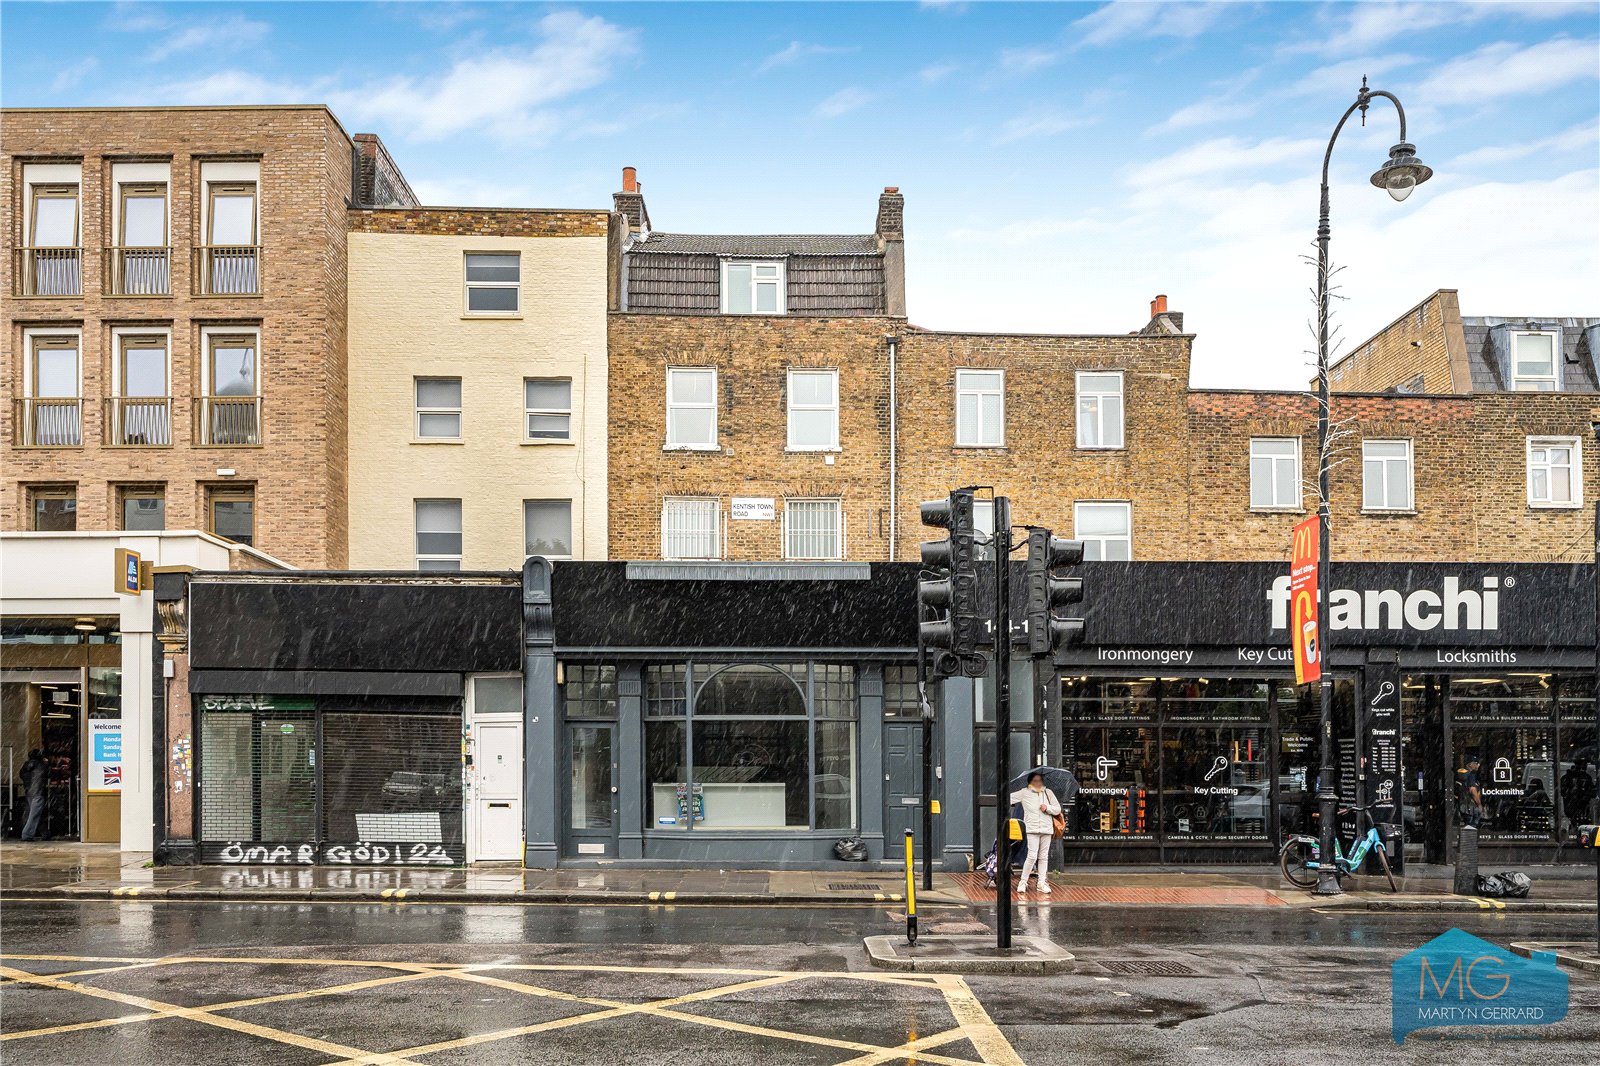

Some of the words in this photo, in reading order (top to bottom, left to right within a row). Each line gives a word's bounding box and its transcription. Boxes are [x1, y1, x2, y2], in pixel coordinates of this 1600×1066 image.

[1267, 576, 1498, 631] fanchi
[1098, 647, 1193, 664] Ironmongery
[1237, 647, 1265, 664] Key
[1437, 649, 1517, 663] Locksmiths
[1079, 787, 1128, 795] Ironmongery
[1194, 786, 1208, 795] Key
[1210, 786, 1238, 795] Cutting
